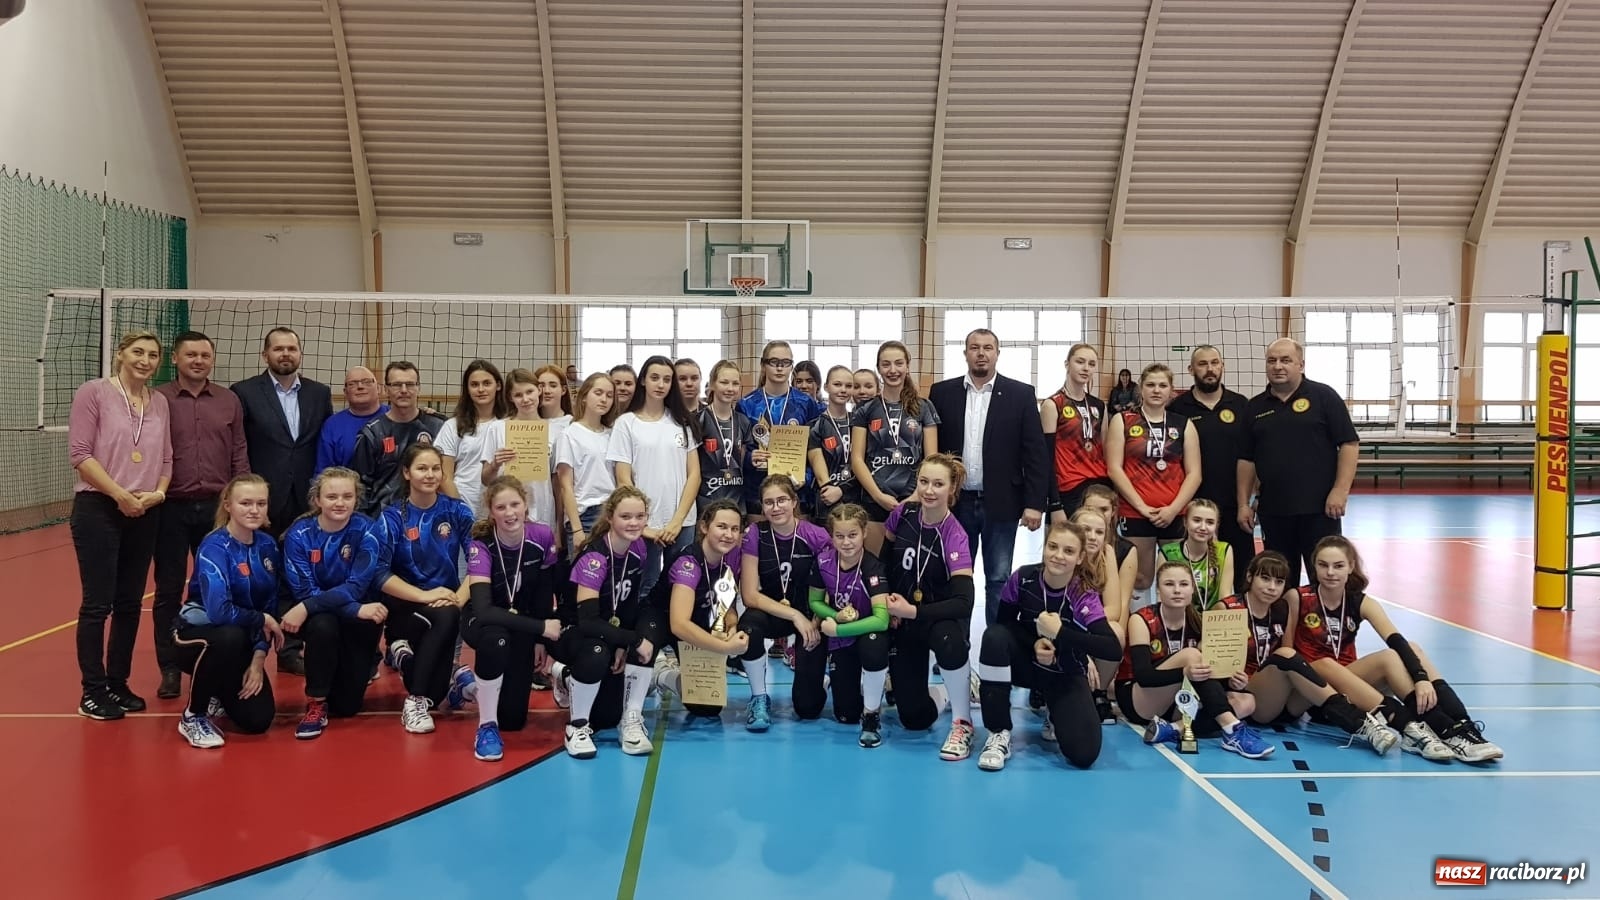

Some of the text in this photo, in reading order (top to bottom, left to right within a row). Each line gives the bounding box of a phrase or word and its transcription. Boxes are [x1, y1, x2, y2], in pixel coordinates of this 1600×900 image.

[1547, 347, 1569, 493] PESMENPOL
[902, 547, 916, 570] 6
[615, 579, 632, 602] 16
